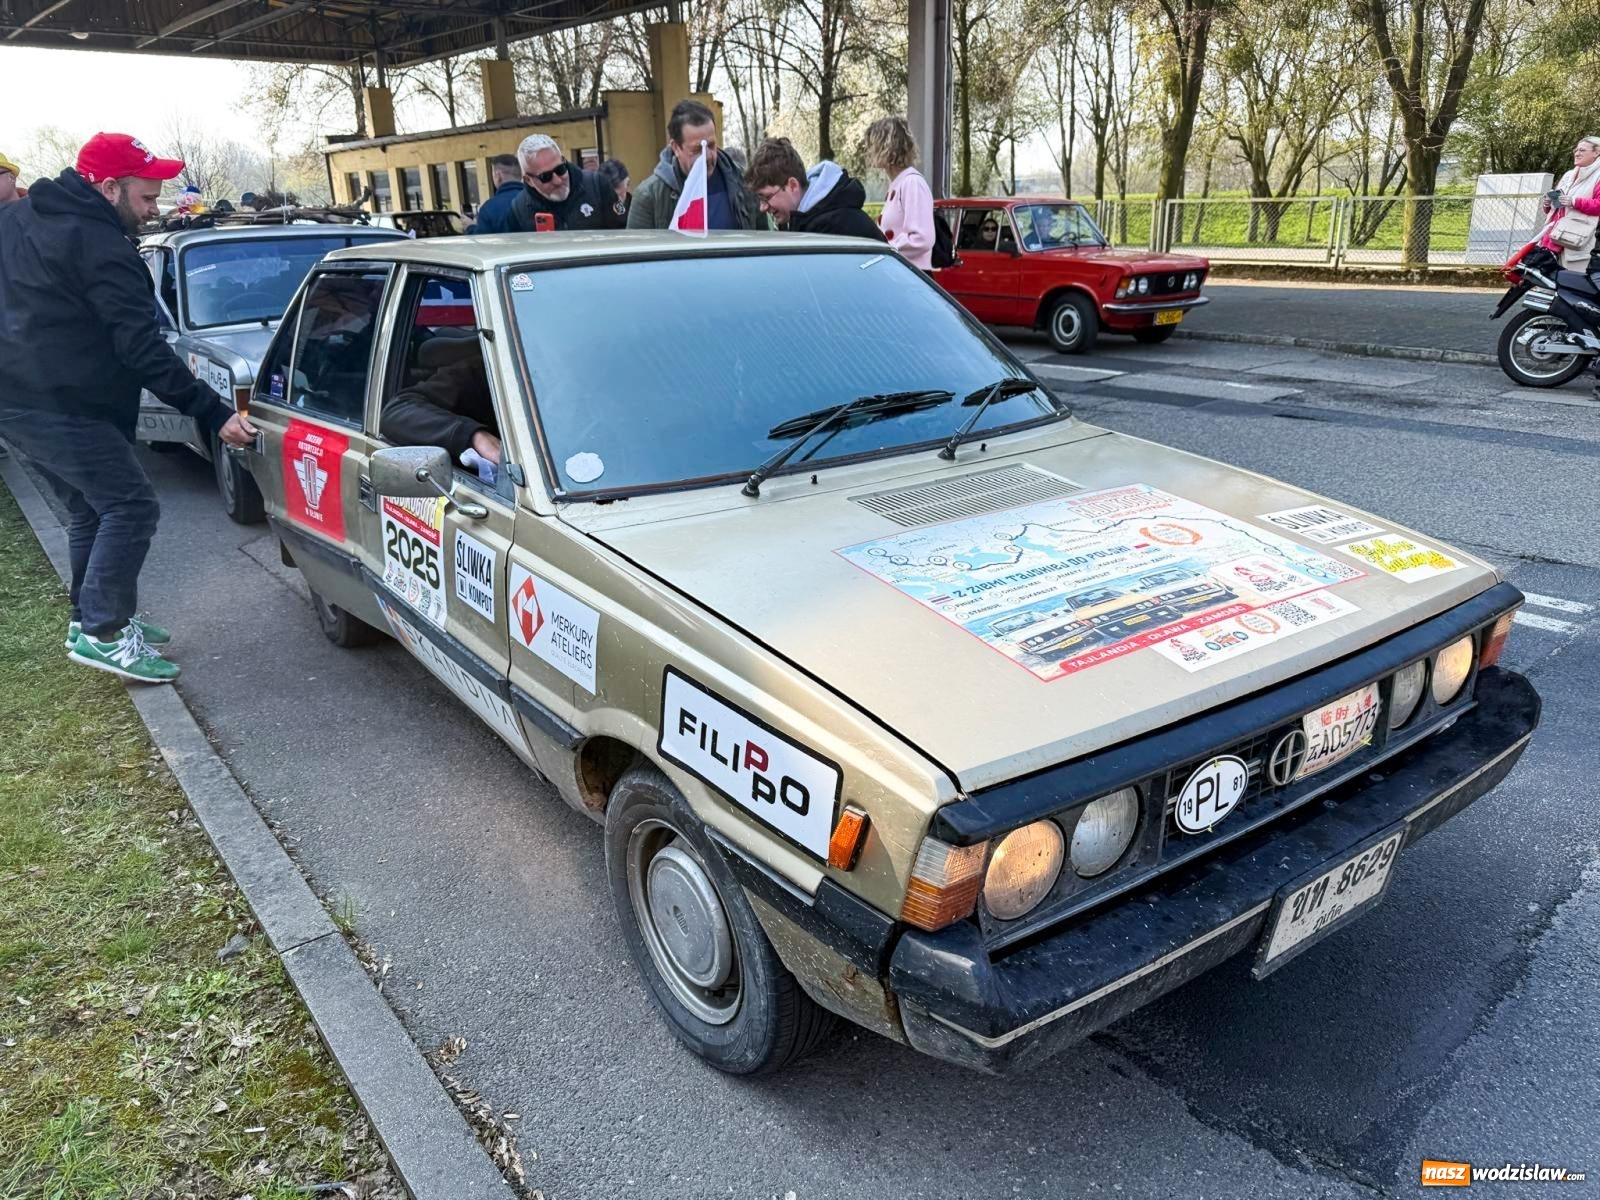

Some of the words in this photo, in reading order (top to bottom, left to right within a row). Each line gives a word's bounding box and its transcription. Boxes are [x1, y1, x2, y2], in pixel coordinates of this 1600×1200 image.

[1268, 508, 1344, 530] ŚLIWKA
[386, 520, 440, 590] 2025
[456, 535, 492, 589] ŚLIWKA
[1067, 556, 1088, 565] DO
[1086, 545, 1131, 560] POLSKI
[468, 582, 492, 614] KOMPOT
[551, 610, 593, 649] MERKURY
[551, 631, 593, 669] ATELIERS
[1068, 642, 1139, 668] TAJLANDIA
[678, 707, 810, 817] FILIPPO
[1183, 798, 1193, 816] 19
[1195, 772, 1229, 822] PL
[1232, 774, 1243, 791] 81
[1337, 838, 1397, 895] 8629
